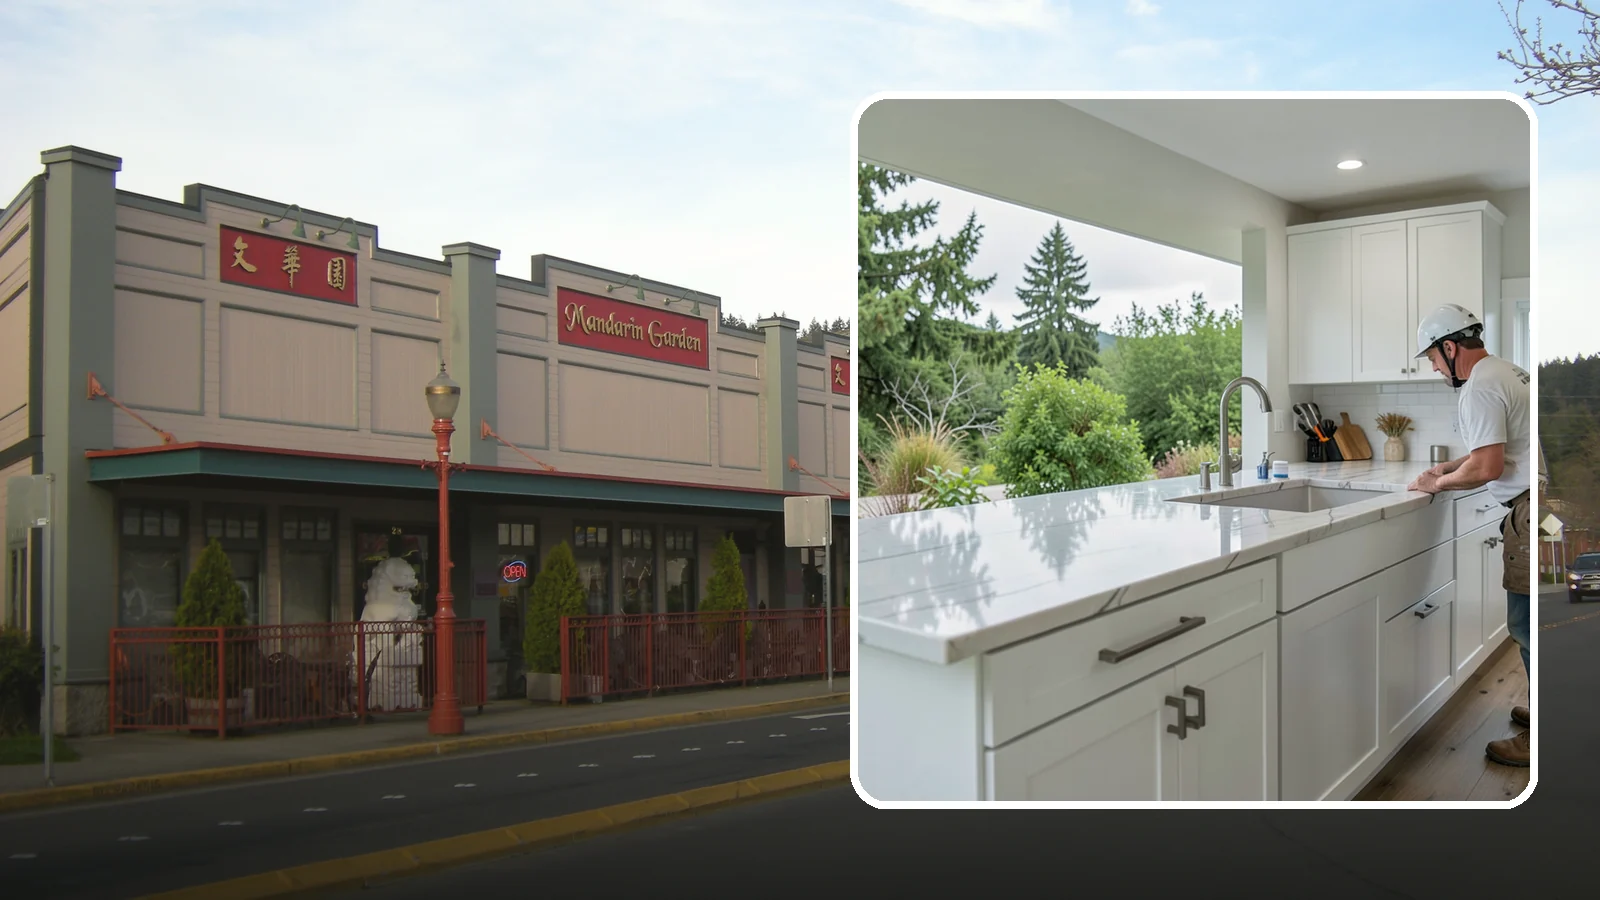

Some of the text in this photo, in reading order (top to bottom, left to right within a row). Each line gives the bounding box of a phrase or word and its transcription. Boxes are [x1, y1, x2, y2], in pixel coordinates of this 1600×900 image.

[230, 235, 346, 291] 文華園
[564, 302, 702, 352] Mandarin Garden
[503, 565, 527, 578] OPEN
